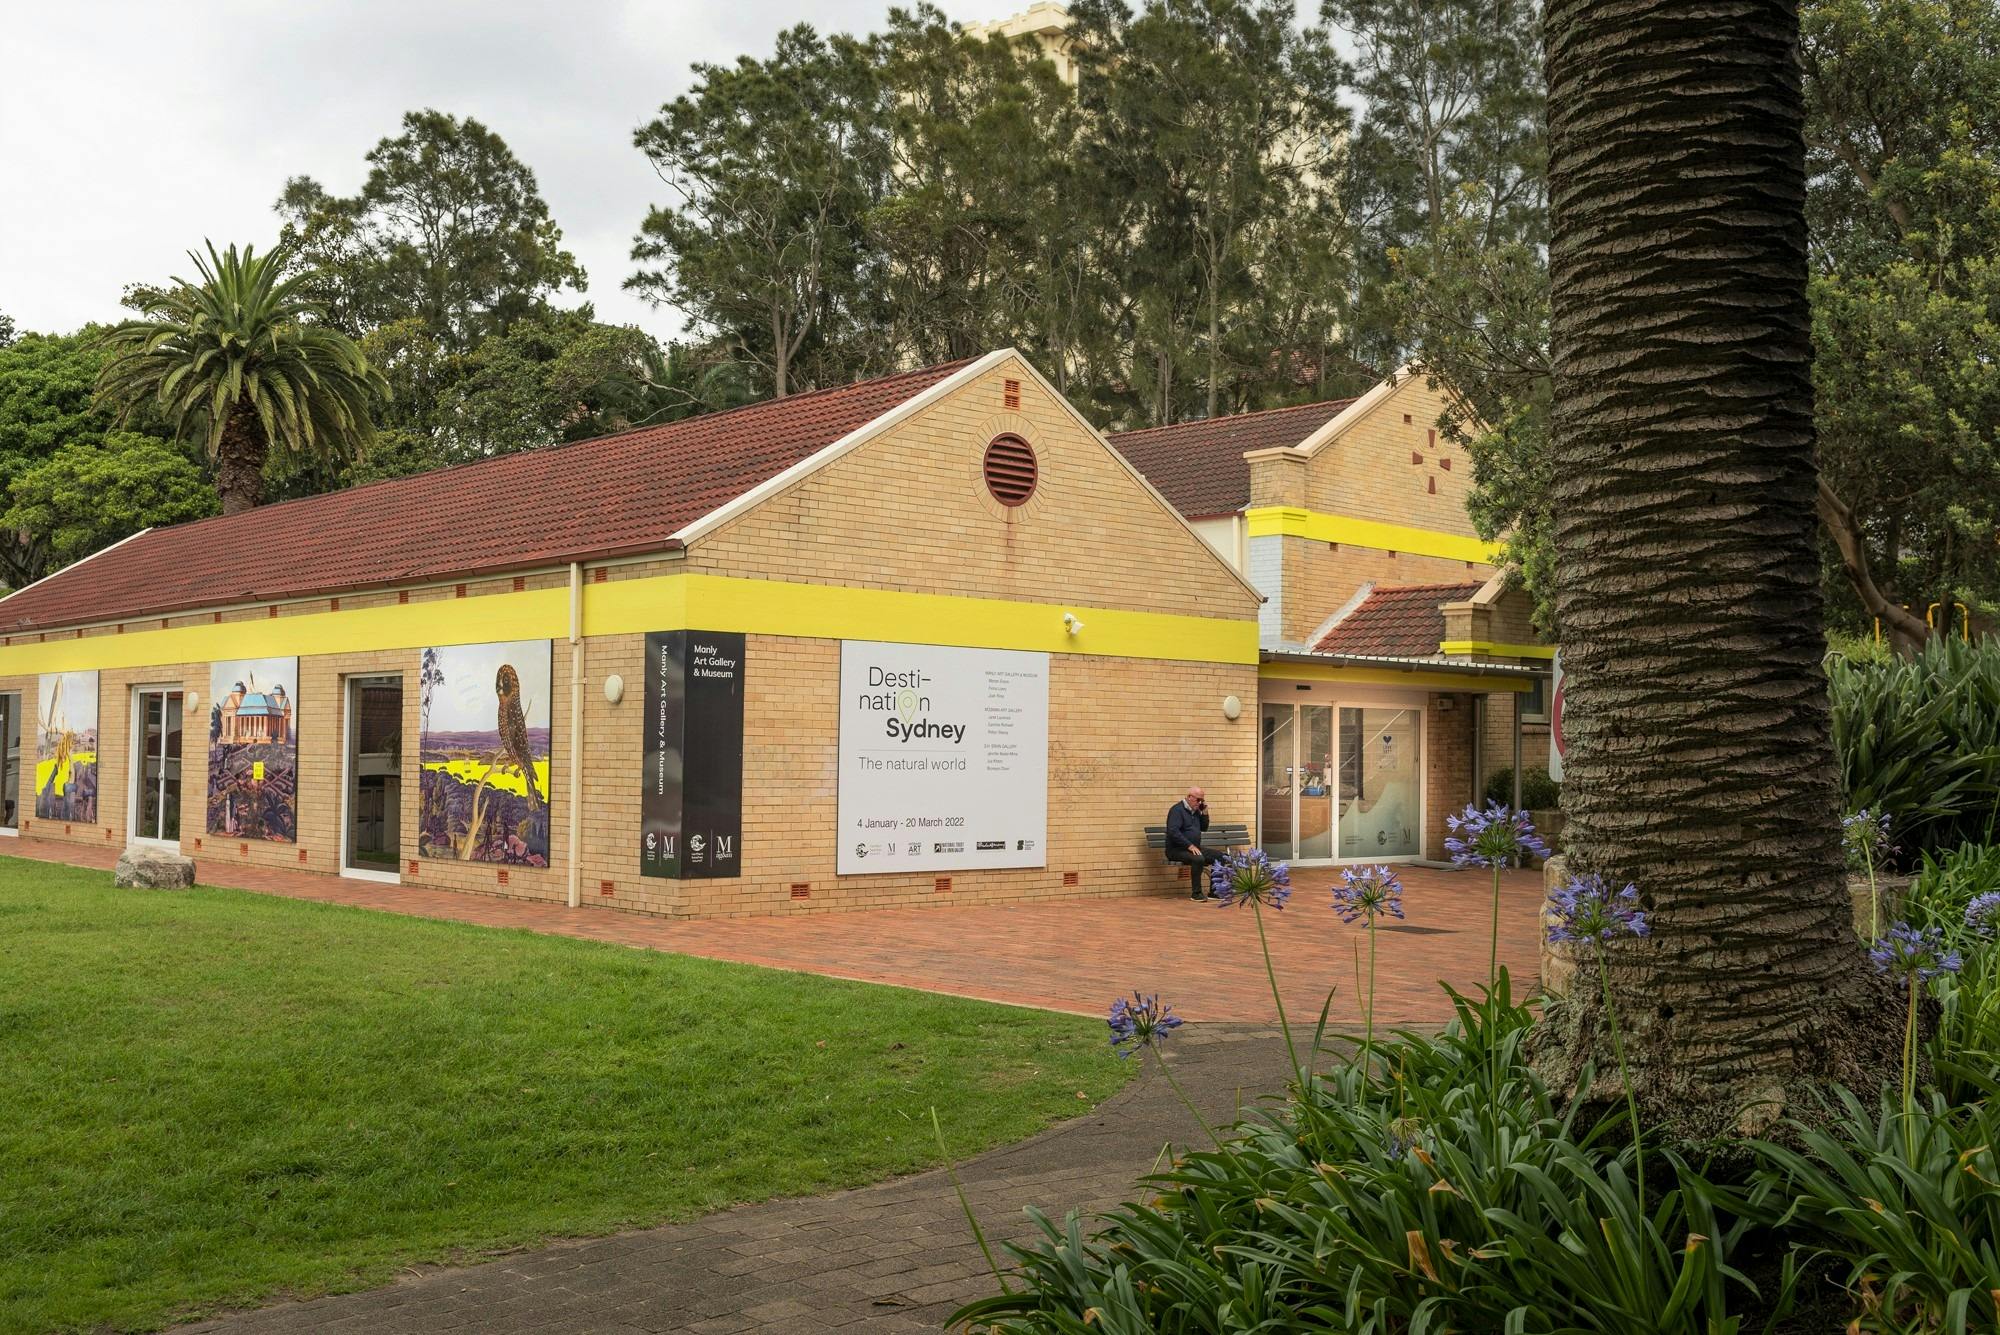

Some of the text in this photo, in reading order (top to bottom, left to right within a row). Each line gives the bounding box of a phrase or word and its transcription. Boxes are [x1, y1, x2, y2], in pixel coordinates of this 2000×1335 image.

[694, 645, 717, 656] Manly
[660, 645, 668, 677] Manly
[693, 657, 736, 669] Art Gallery
[693, 668, 733, 678] & Museum
[869, 666, 931, 688] Desti-
[658, 700, 667, 738] Gallery
[886, 718, 966, 744] Sydney
[659, 740, 666, 748] &
[858, 756, 966, 770] The natural world
[857, 818, 863, 828] 4
[865, 818, 898, 830] January
[905, 818, 917, 828] 20
[918, 817, 943, 827] March
[945, 816, 965, 827] 2022
[908, 845, 921, 853] ART
